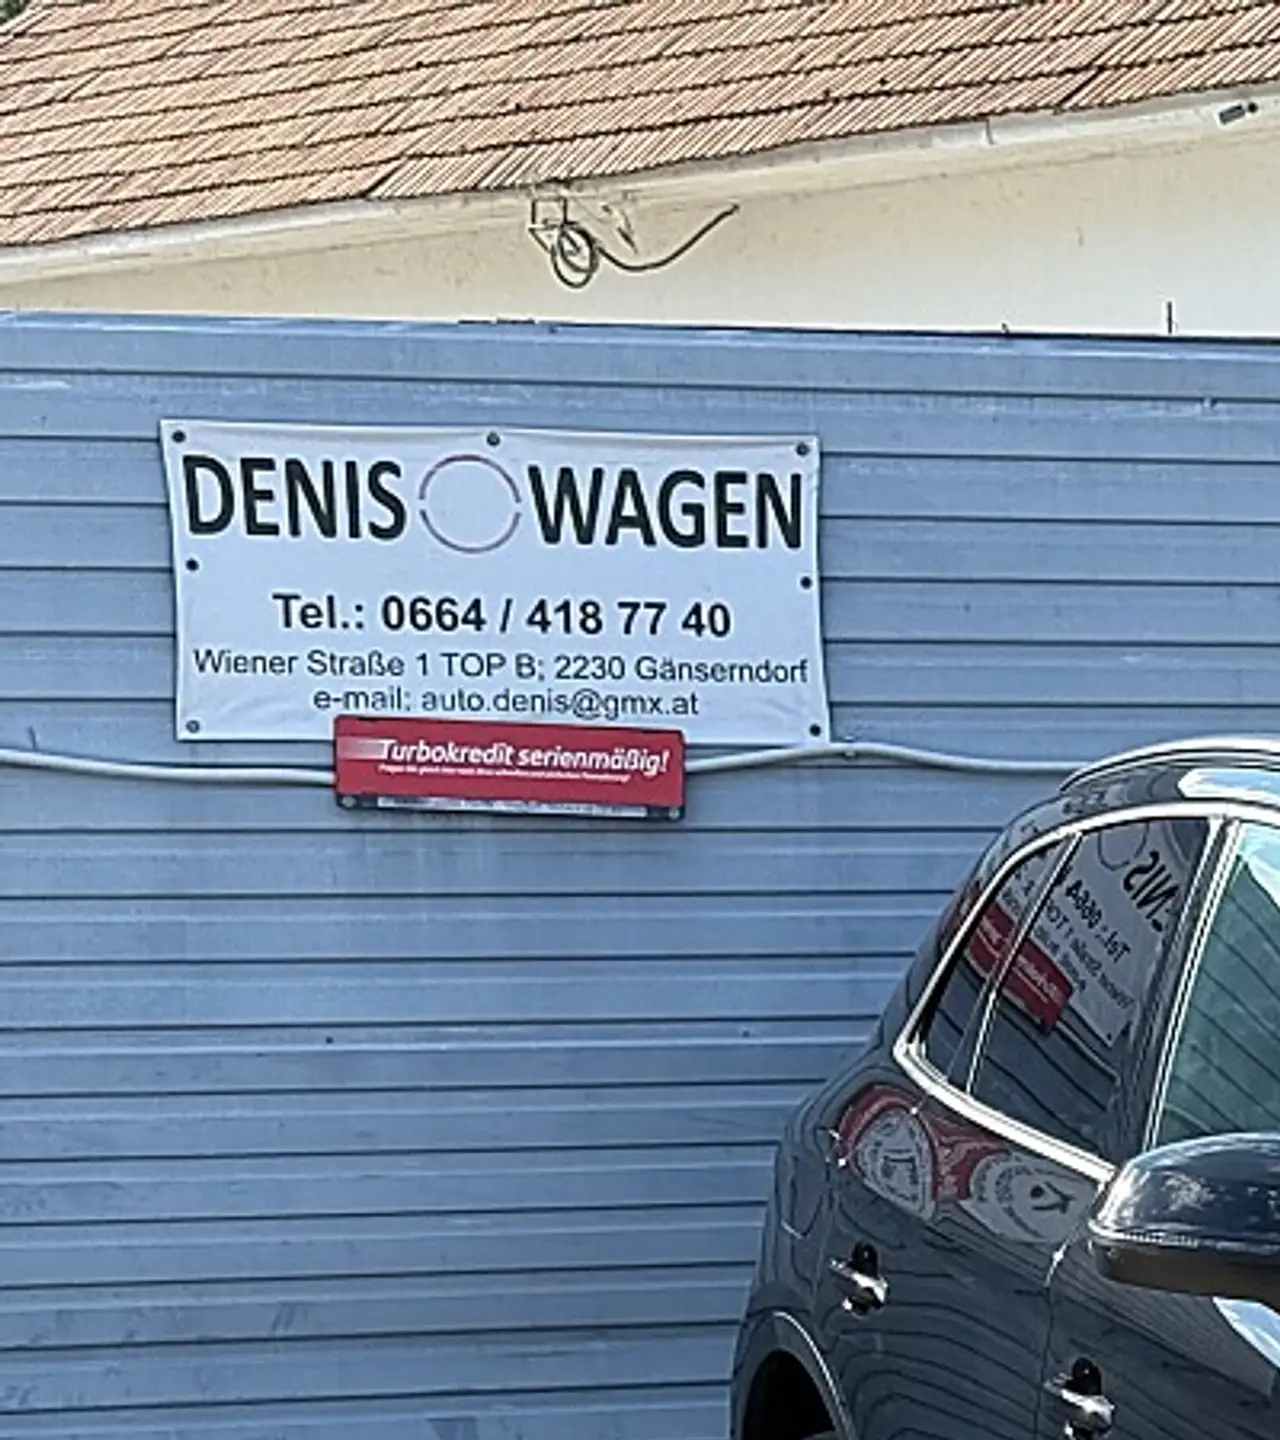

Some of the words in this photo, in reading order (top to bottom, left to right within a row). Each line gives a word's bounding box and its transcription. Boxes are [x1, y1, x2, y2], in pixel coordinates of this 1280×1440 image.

[182, 454, 404, 540] DENIS
[528, 464, 804, 550] WAGEN
[272, 593, 365, 630] Tel.:
[381, 595, 486, 632] 0664
[500, 598, 513, 634] /
[526, 598, 603, 636] 418
[617, 601, 667, 636] 77
[682, 602, 732, 638] 40
[193, 648, 298, 675] Wiener
[307, 650, 405, 677] Straße
[416, 652, 429, 677] 1
[440, 652, 506, 679] TOP
[515, 653, 545, 682] B;
[554, 655, 626, 681] 2230
[635, 655, 809, 684] Gänserndorf
[313, 686, 411, 712] e-mail:
[421, 687, 700, 720] auto.denis@gmx.at
[380, 738, 514, 767] Turbokredit
[518, 747, 671, 777] serienmäßig!
